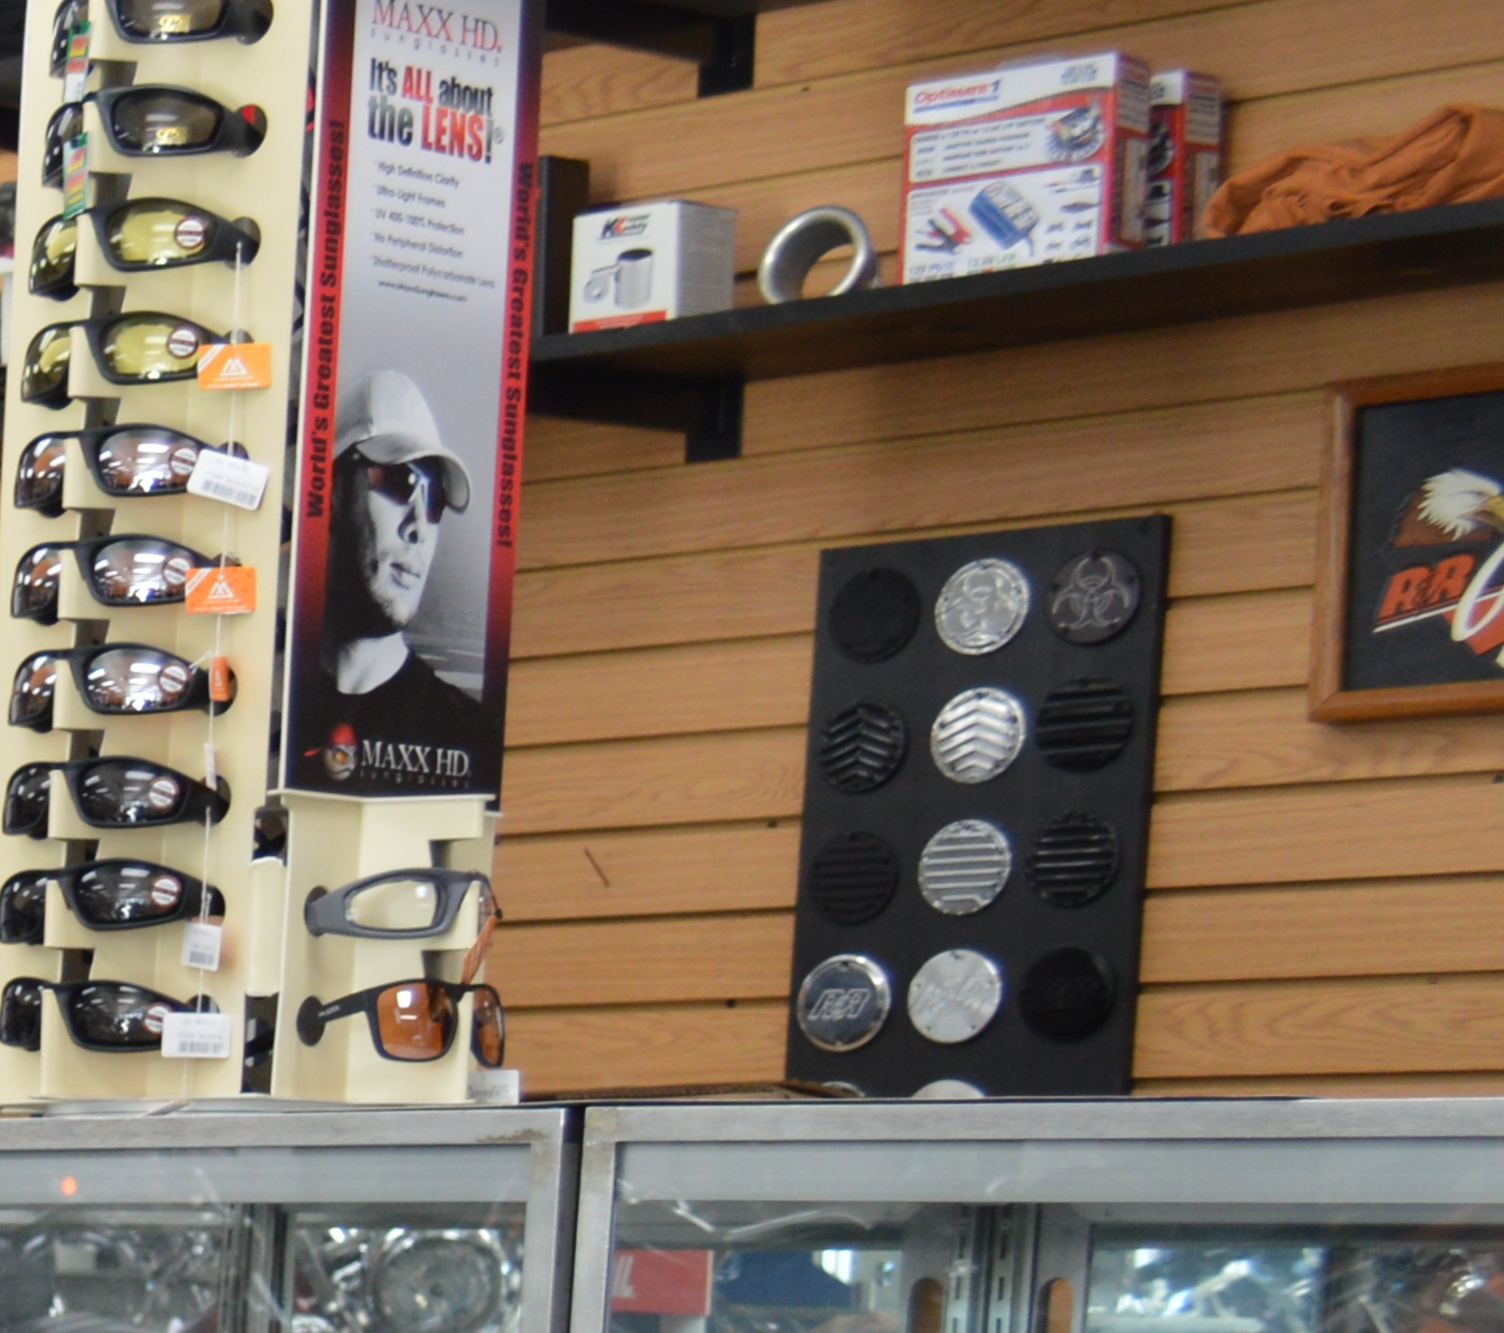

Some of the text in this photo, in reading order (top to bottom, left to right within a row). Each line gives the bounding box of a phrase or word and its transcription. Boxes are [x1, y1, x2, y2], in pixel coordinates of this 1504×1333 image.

[372, 0, 454, 42] MAXX
[370, 57, 493, 117] It's ALL about
[368, 95, 494, 164] the LENS!
[305, 119, 346, 519] World's Greatest Sunglasses!
[497, 163, 534, 549] World's Greatest Sunglasses!
[361, 740, 469, 777] MAXX HD
